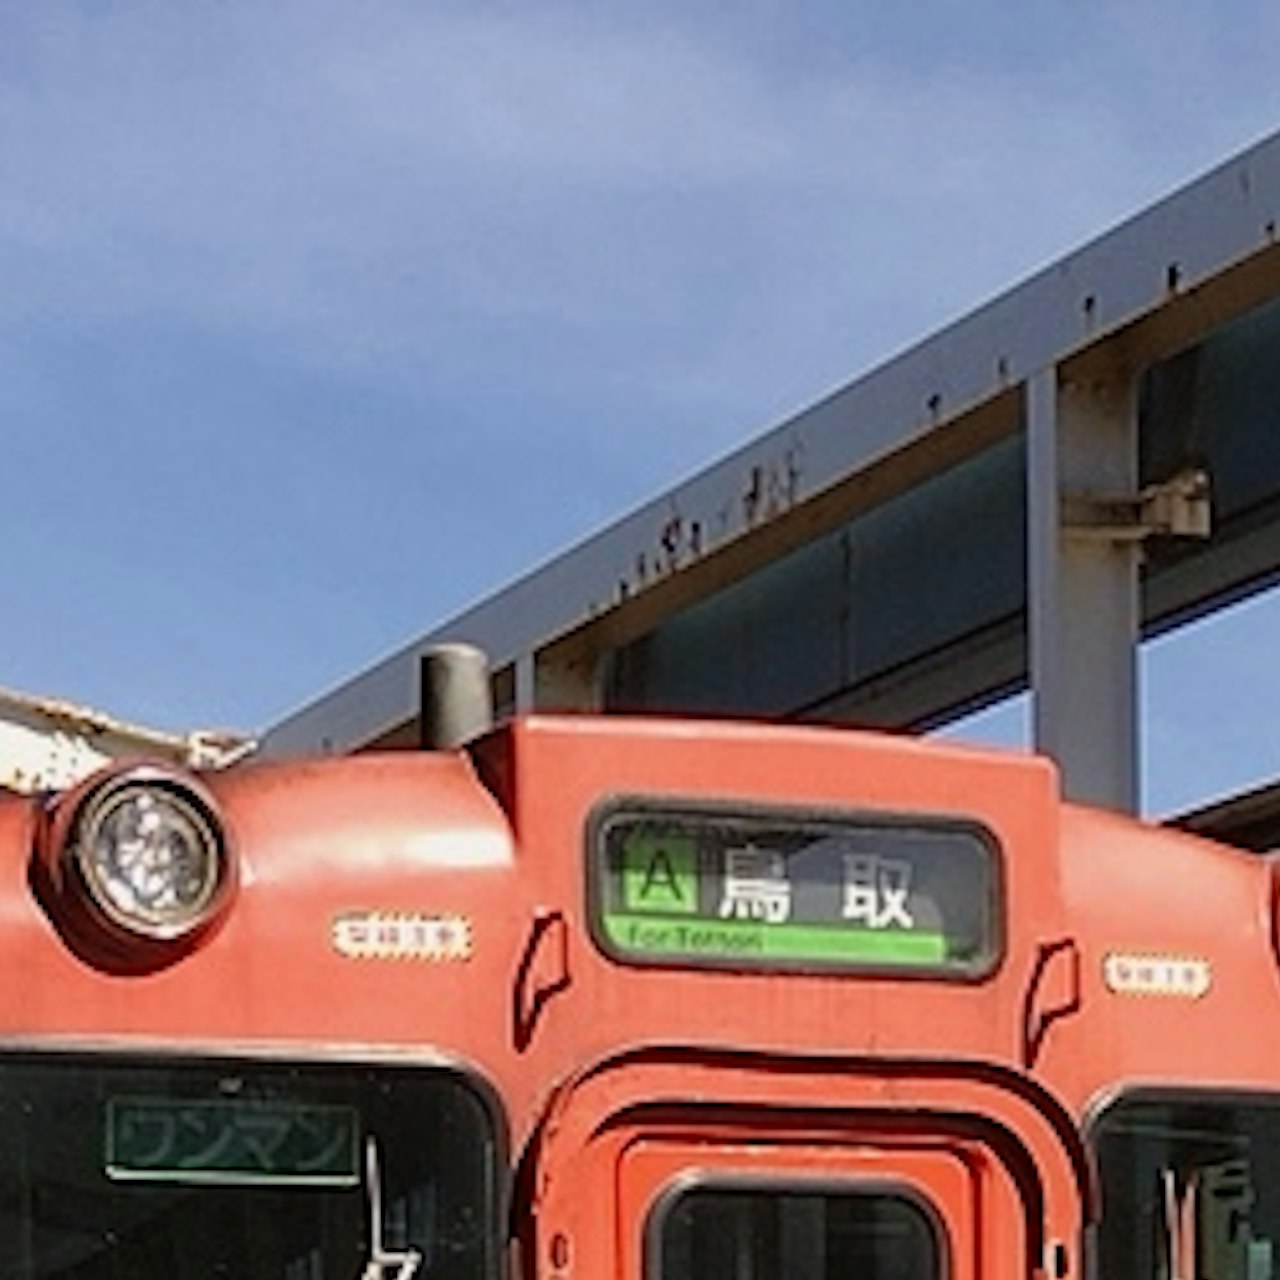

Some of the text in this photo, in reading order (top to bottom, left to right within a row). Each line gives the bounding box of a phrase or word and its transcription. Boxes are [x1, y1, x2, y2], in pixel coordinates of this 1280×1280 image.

[638, 848, 684, 901] A
[120, 1110, 349, 1170] ワンマン
